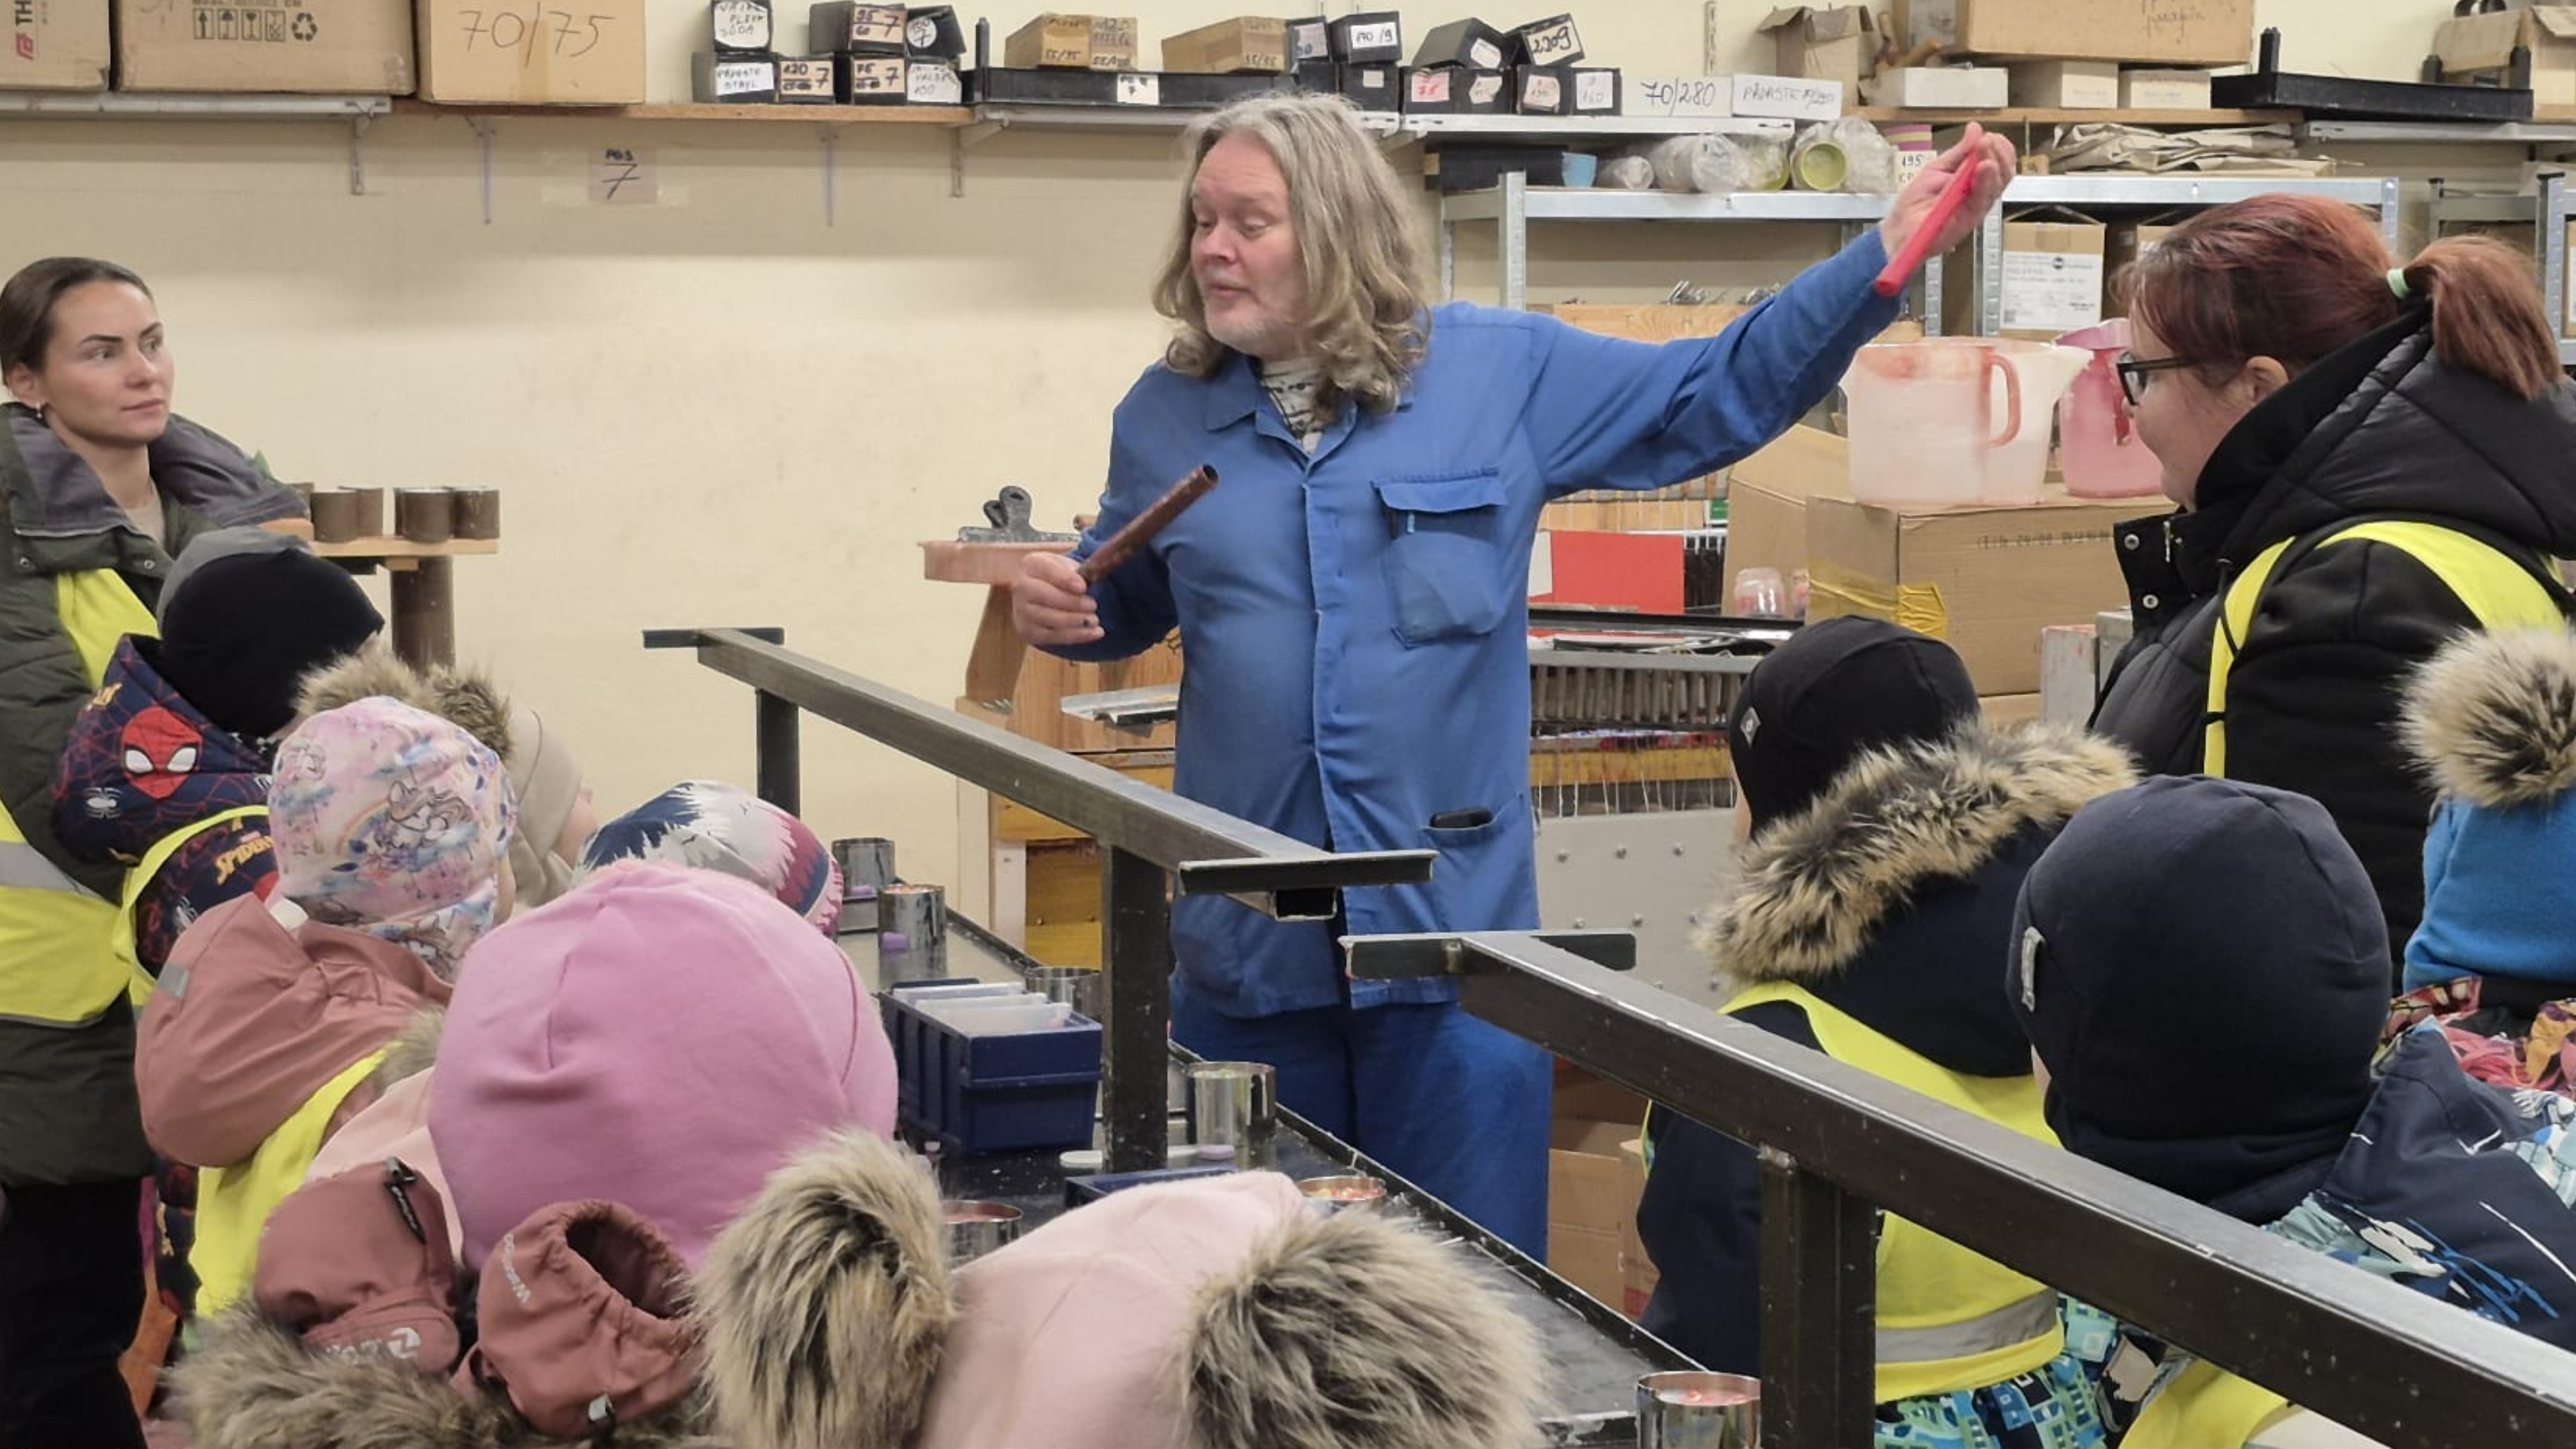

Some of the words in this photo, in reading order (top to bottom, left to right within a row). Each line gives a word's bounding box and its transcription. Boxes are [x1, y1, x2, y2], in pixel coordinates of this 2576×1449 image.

[458, 0, 617, 69] 70/75
[1640, 77, 1717, 117] 70/280
[601, 163, 641, 200] 7
